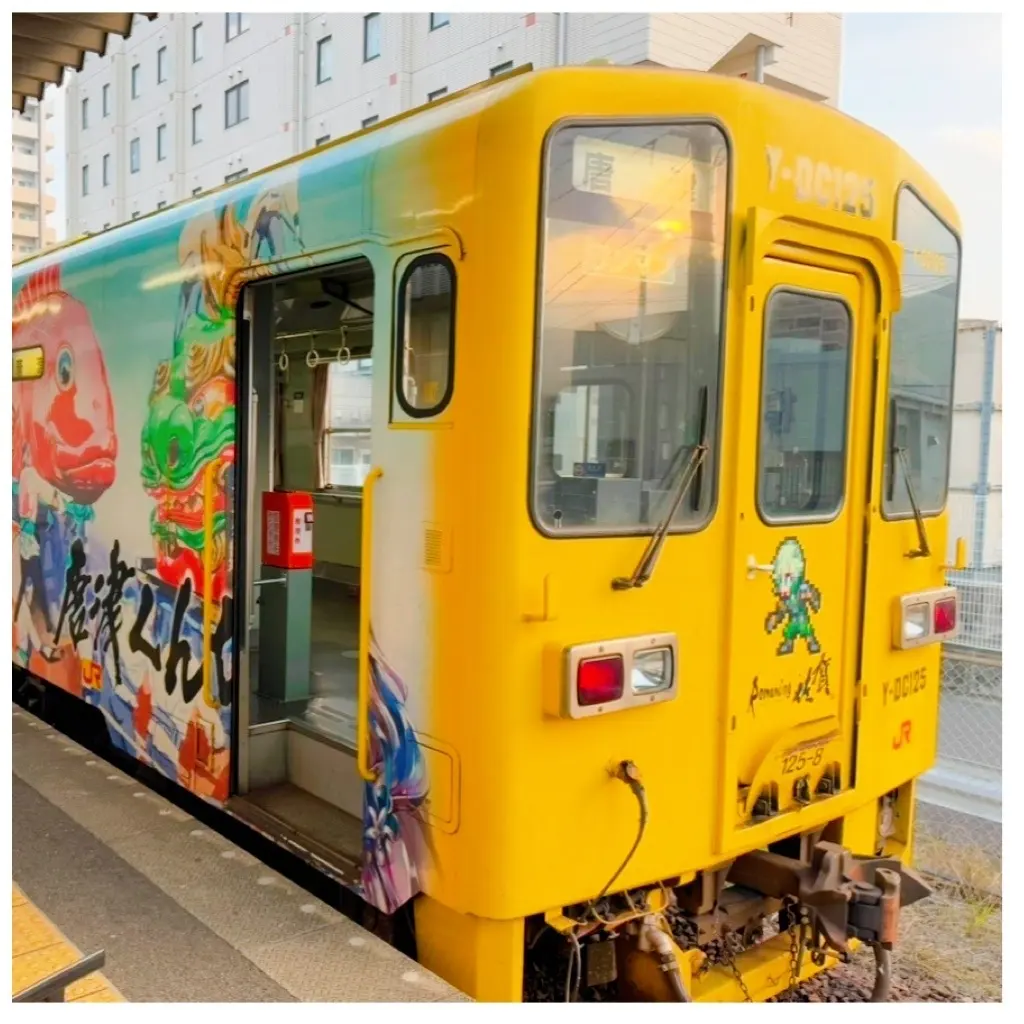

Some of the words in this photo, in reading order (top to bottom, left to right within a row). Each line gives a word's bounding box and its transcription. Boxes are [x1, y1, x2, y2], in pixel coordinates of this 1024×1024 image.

[765, 144, 876, 219] Y-DC125
[82, 659, 103, 688] JR
[882, 666, 927, 707] Y-DC125
[892, 721, 912, 750] JR
[781, 748, 824, 775] 125-8
